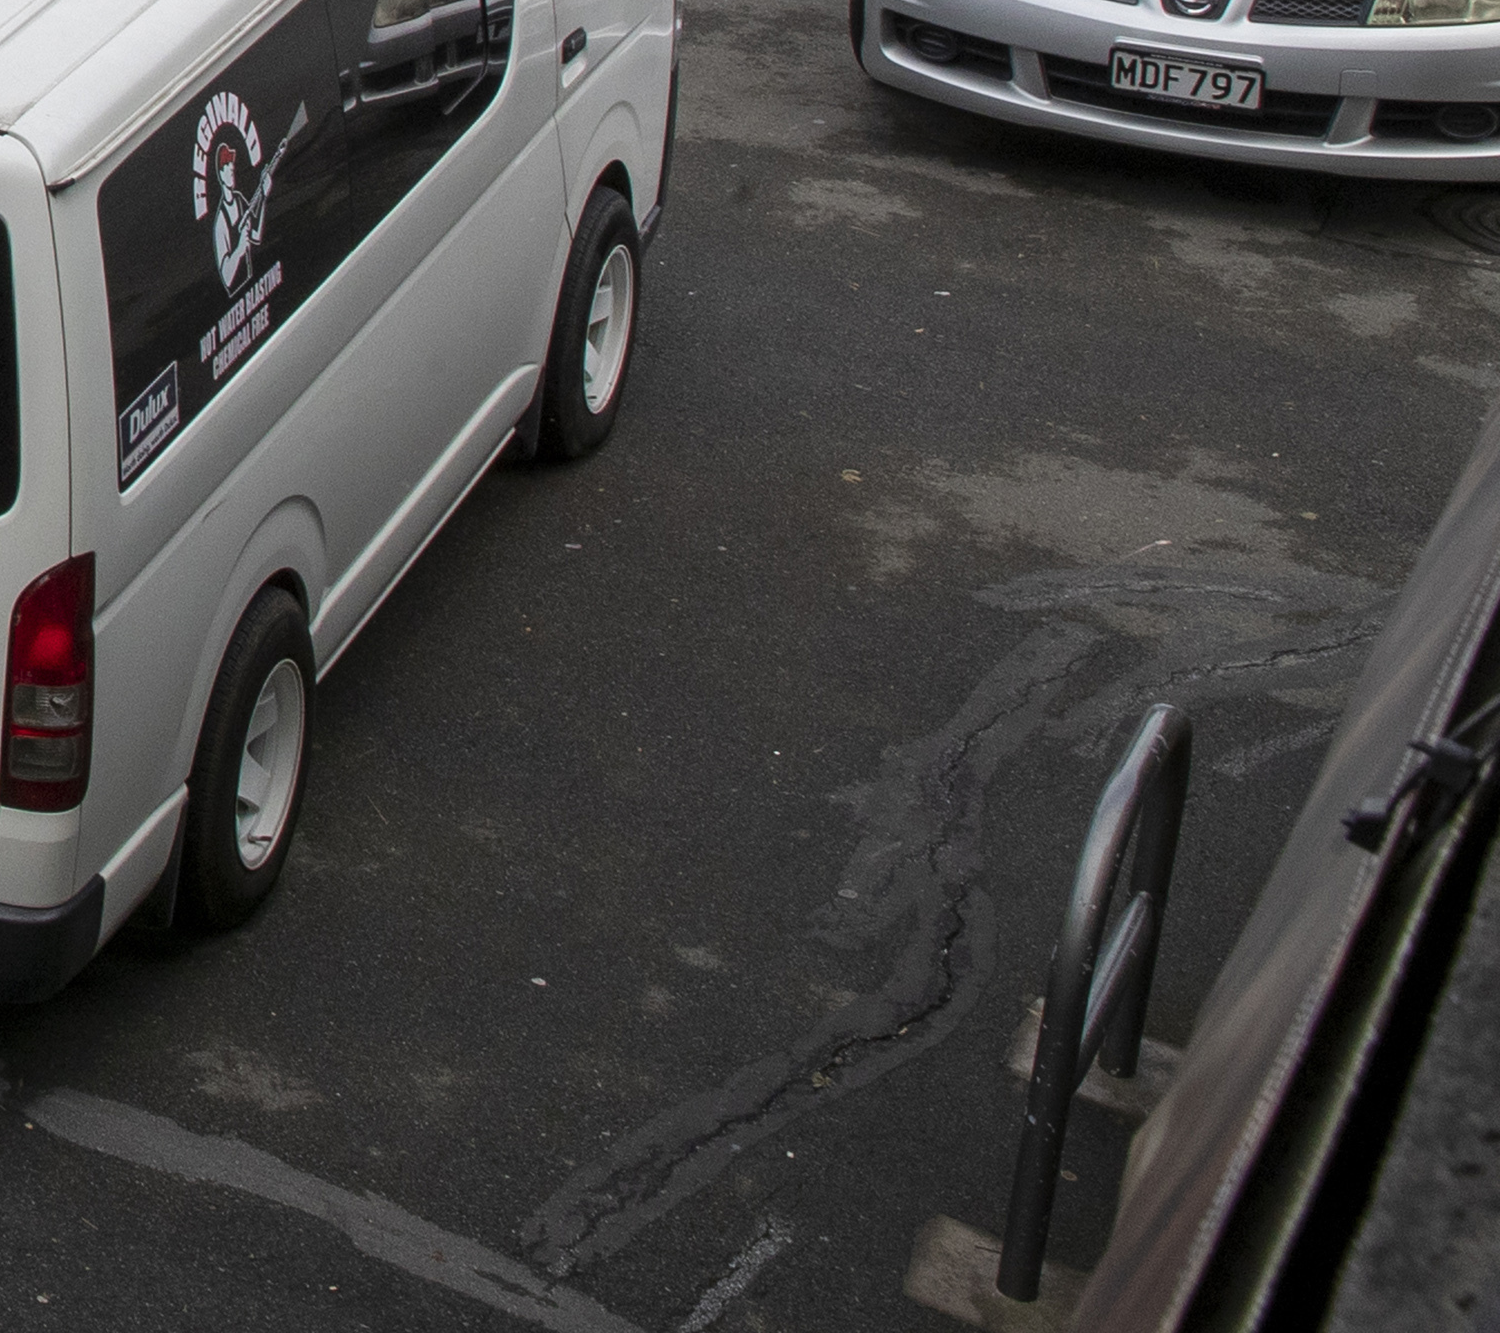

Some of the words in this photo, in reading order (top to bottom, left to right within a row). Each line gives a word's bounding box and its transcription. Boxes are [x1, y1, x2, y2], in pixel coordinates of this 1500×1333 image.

[1115, 56, 1257, 104] MDF797
[193, 92, 261, 220] REGINALD
[200, 325, 217, 363] HOT
[218, 297, 245, 344] WATER
[245, 260, 283, 317] BLASTING
[213, 322, 251, 380] CHEMICAL
[251, 303, 269, 340] FREE
[129, 384, 171, 444] Dulux
